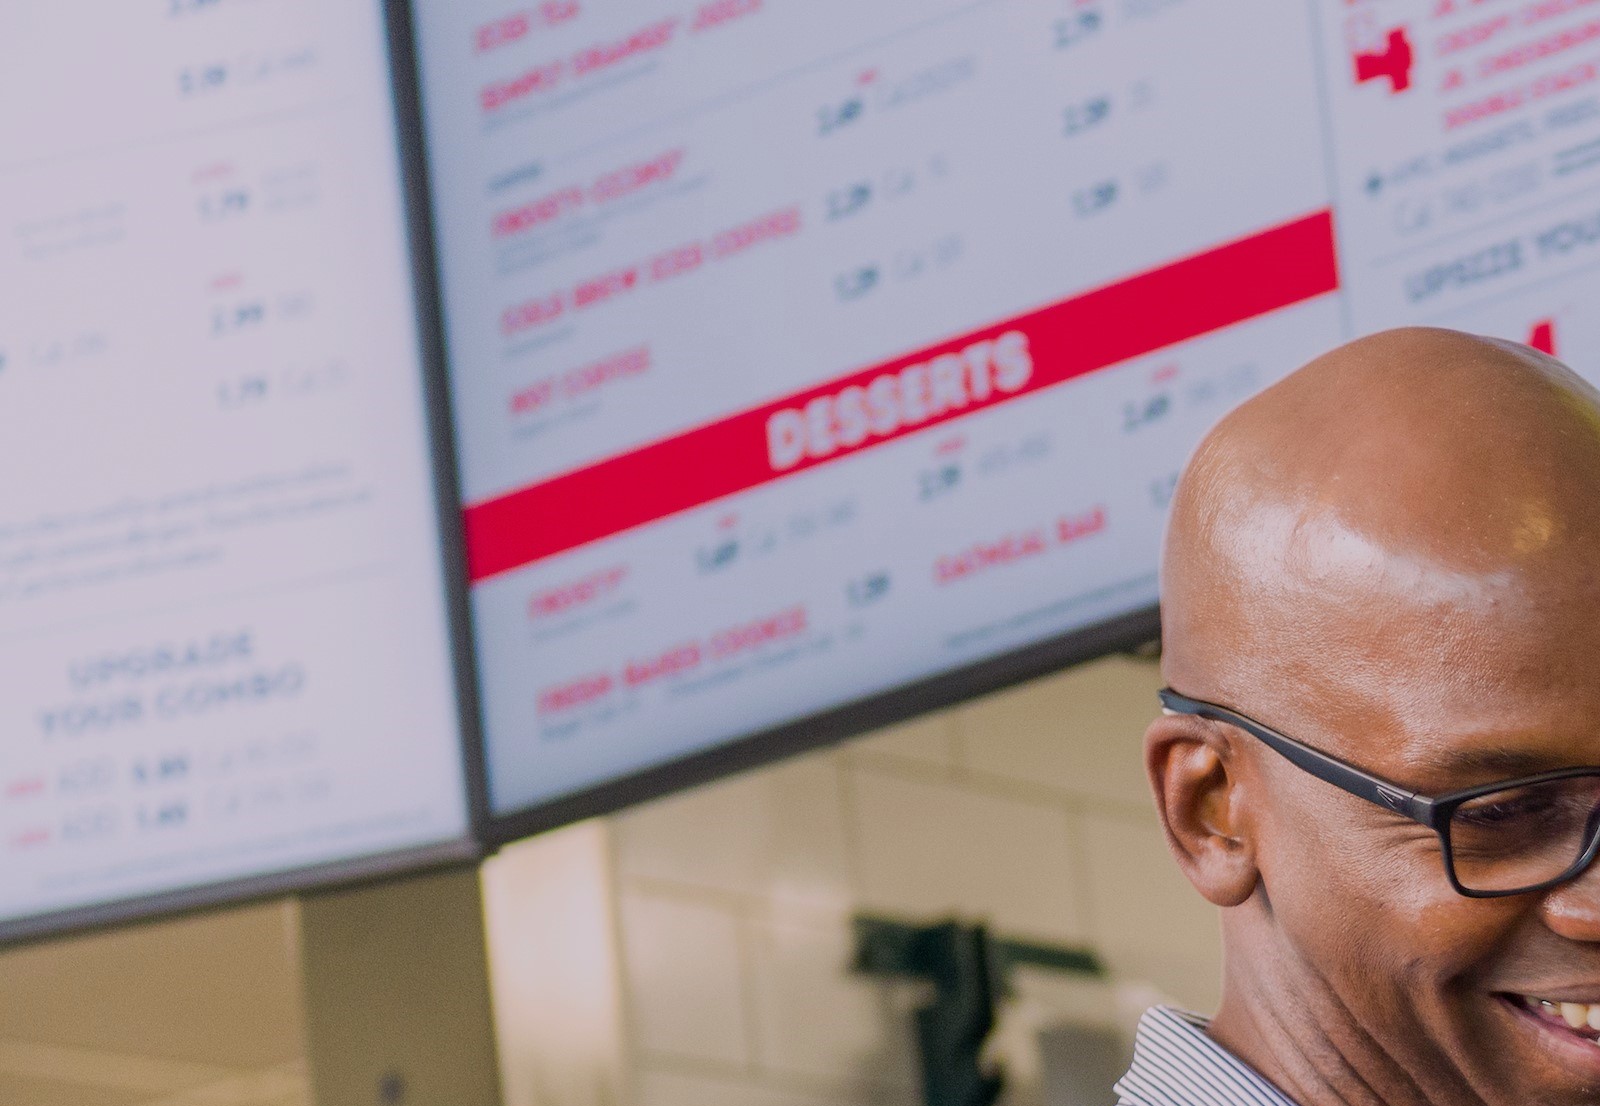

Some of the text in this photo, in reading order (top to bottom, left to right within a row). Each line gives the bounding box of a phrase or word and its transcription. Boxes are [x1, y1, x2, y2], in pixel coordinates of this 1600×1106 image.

[767, 330, 1034, 471] DESSERTS
[40, 659, 308, 738] YOUR COMBO
[67, 630, 255, 691] UPGRADE
